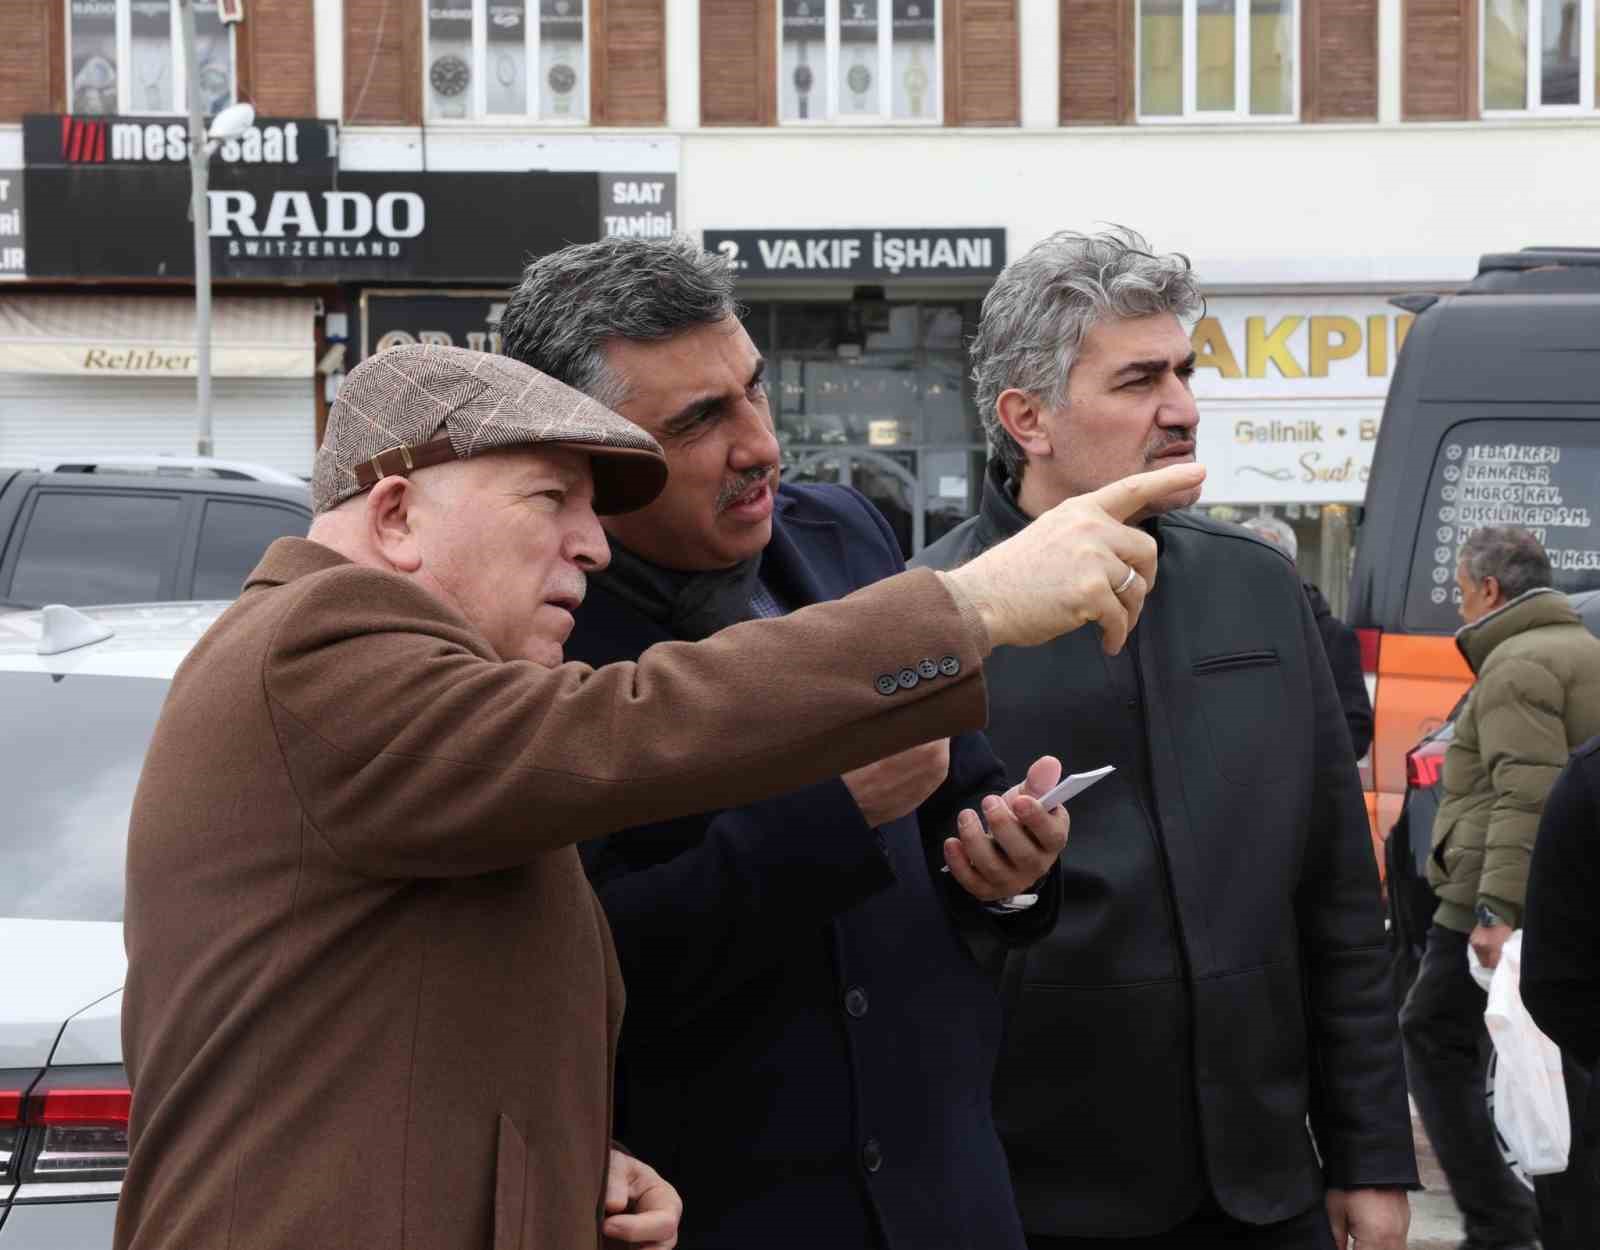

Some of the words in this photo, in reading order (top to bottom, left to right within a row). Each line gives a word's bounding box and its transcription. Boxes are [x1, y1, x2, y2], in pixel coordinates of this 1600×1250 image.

[112, 124, 192, 162] mes
[220, 122, 298, 163] saat
[613, 181, 664, 204] SAAT
[207, 190, 425, 237] RADO
[604, 211, 672, 238] TAMİRİ
[228, 240, 401, 257] SWITZERLAND
[718, 239, 748, 269] 2.
[758, 238, 861, 269] VAKIF
[872, 232, 992, 274] İŞHANI
[83, 348, 194, 370] Rehber
